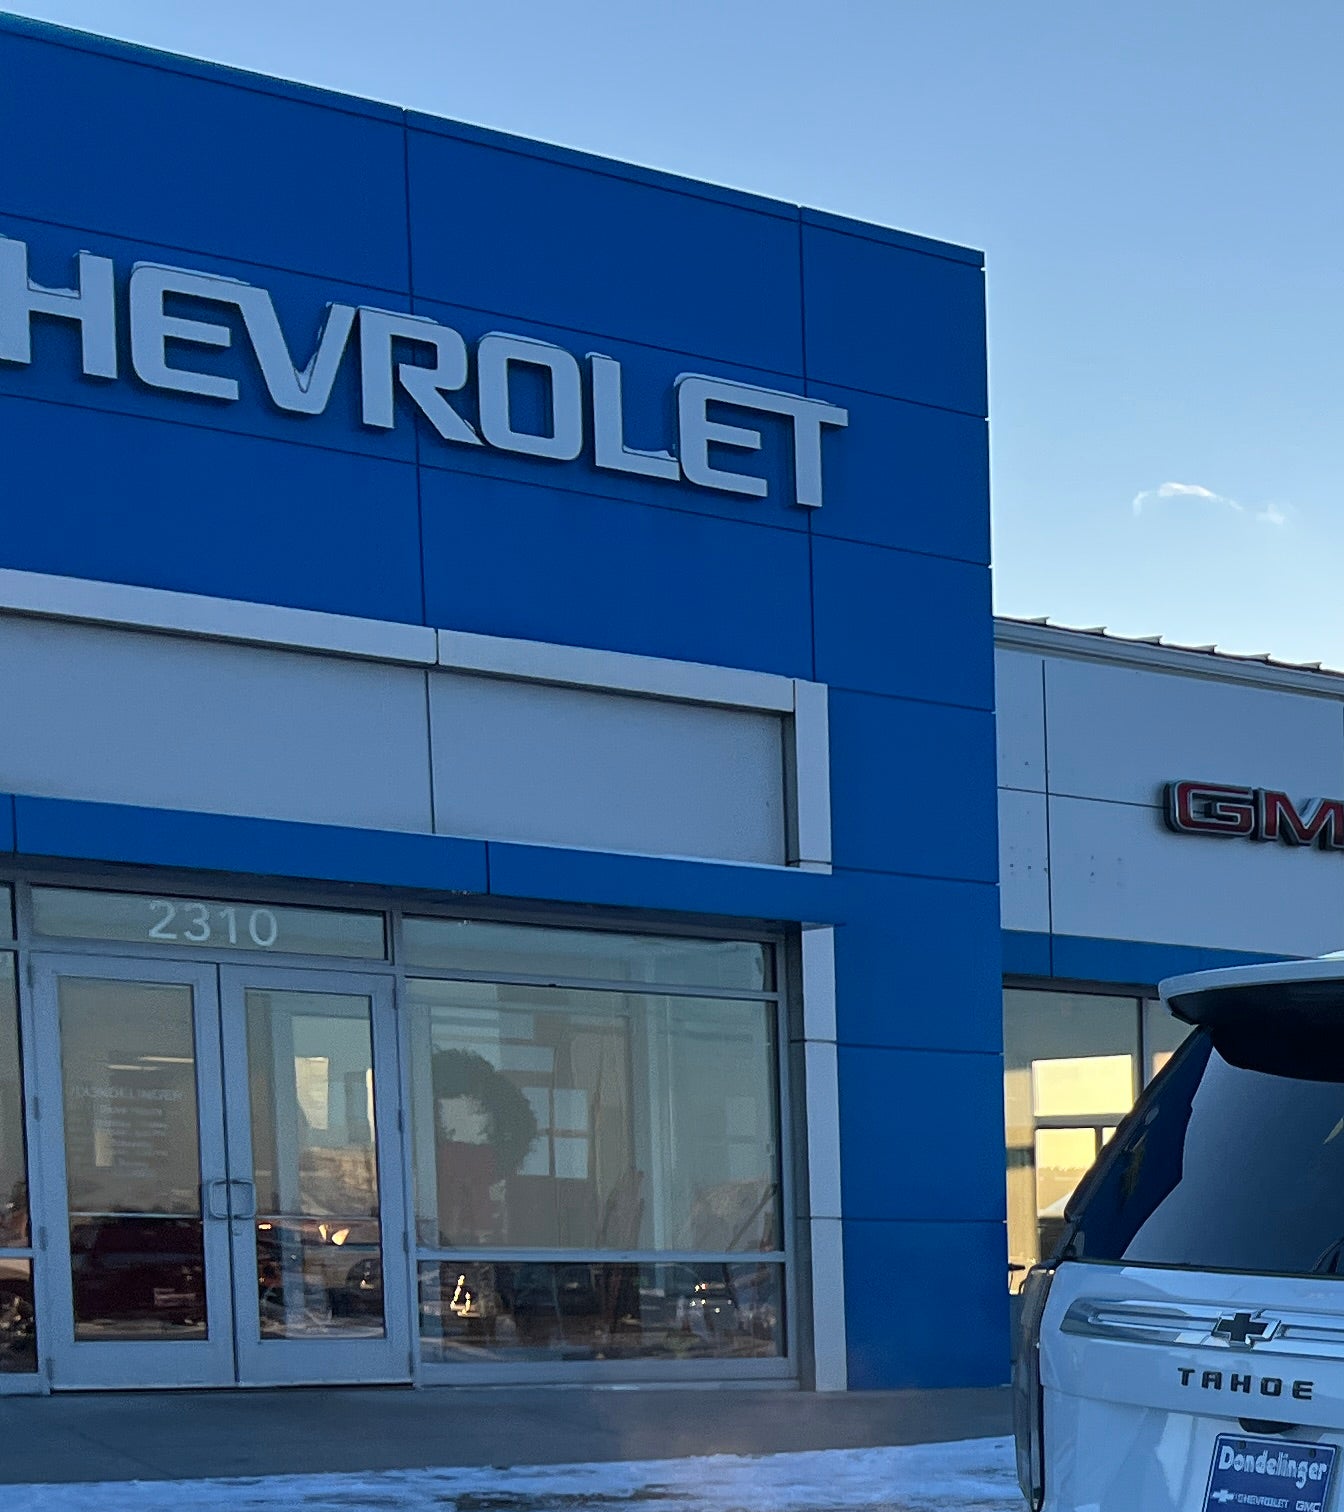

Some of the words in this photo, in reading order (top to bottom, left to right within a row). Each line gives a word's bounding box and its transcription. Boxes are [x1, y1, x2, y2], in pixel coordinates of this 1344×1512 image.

[149, 900, 278, 946] 2310
[1177, 1367, 1314, 1400] TAHOE
[1218, 1445, 1328, 1489] Dondelinger
